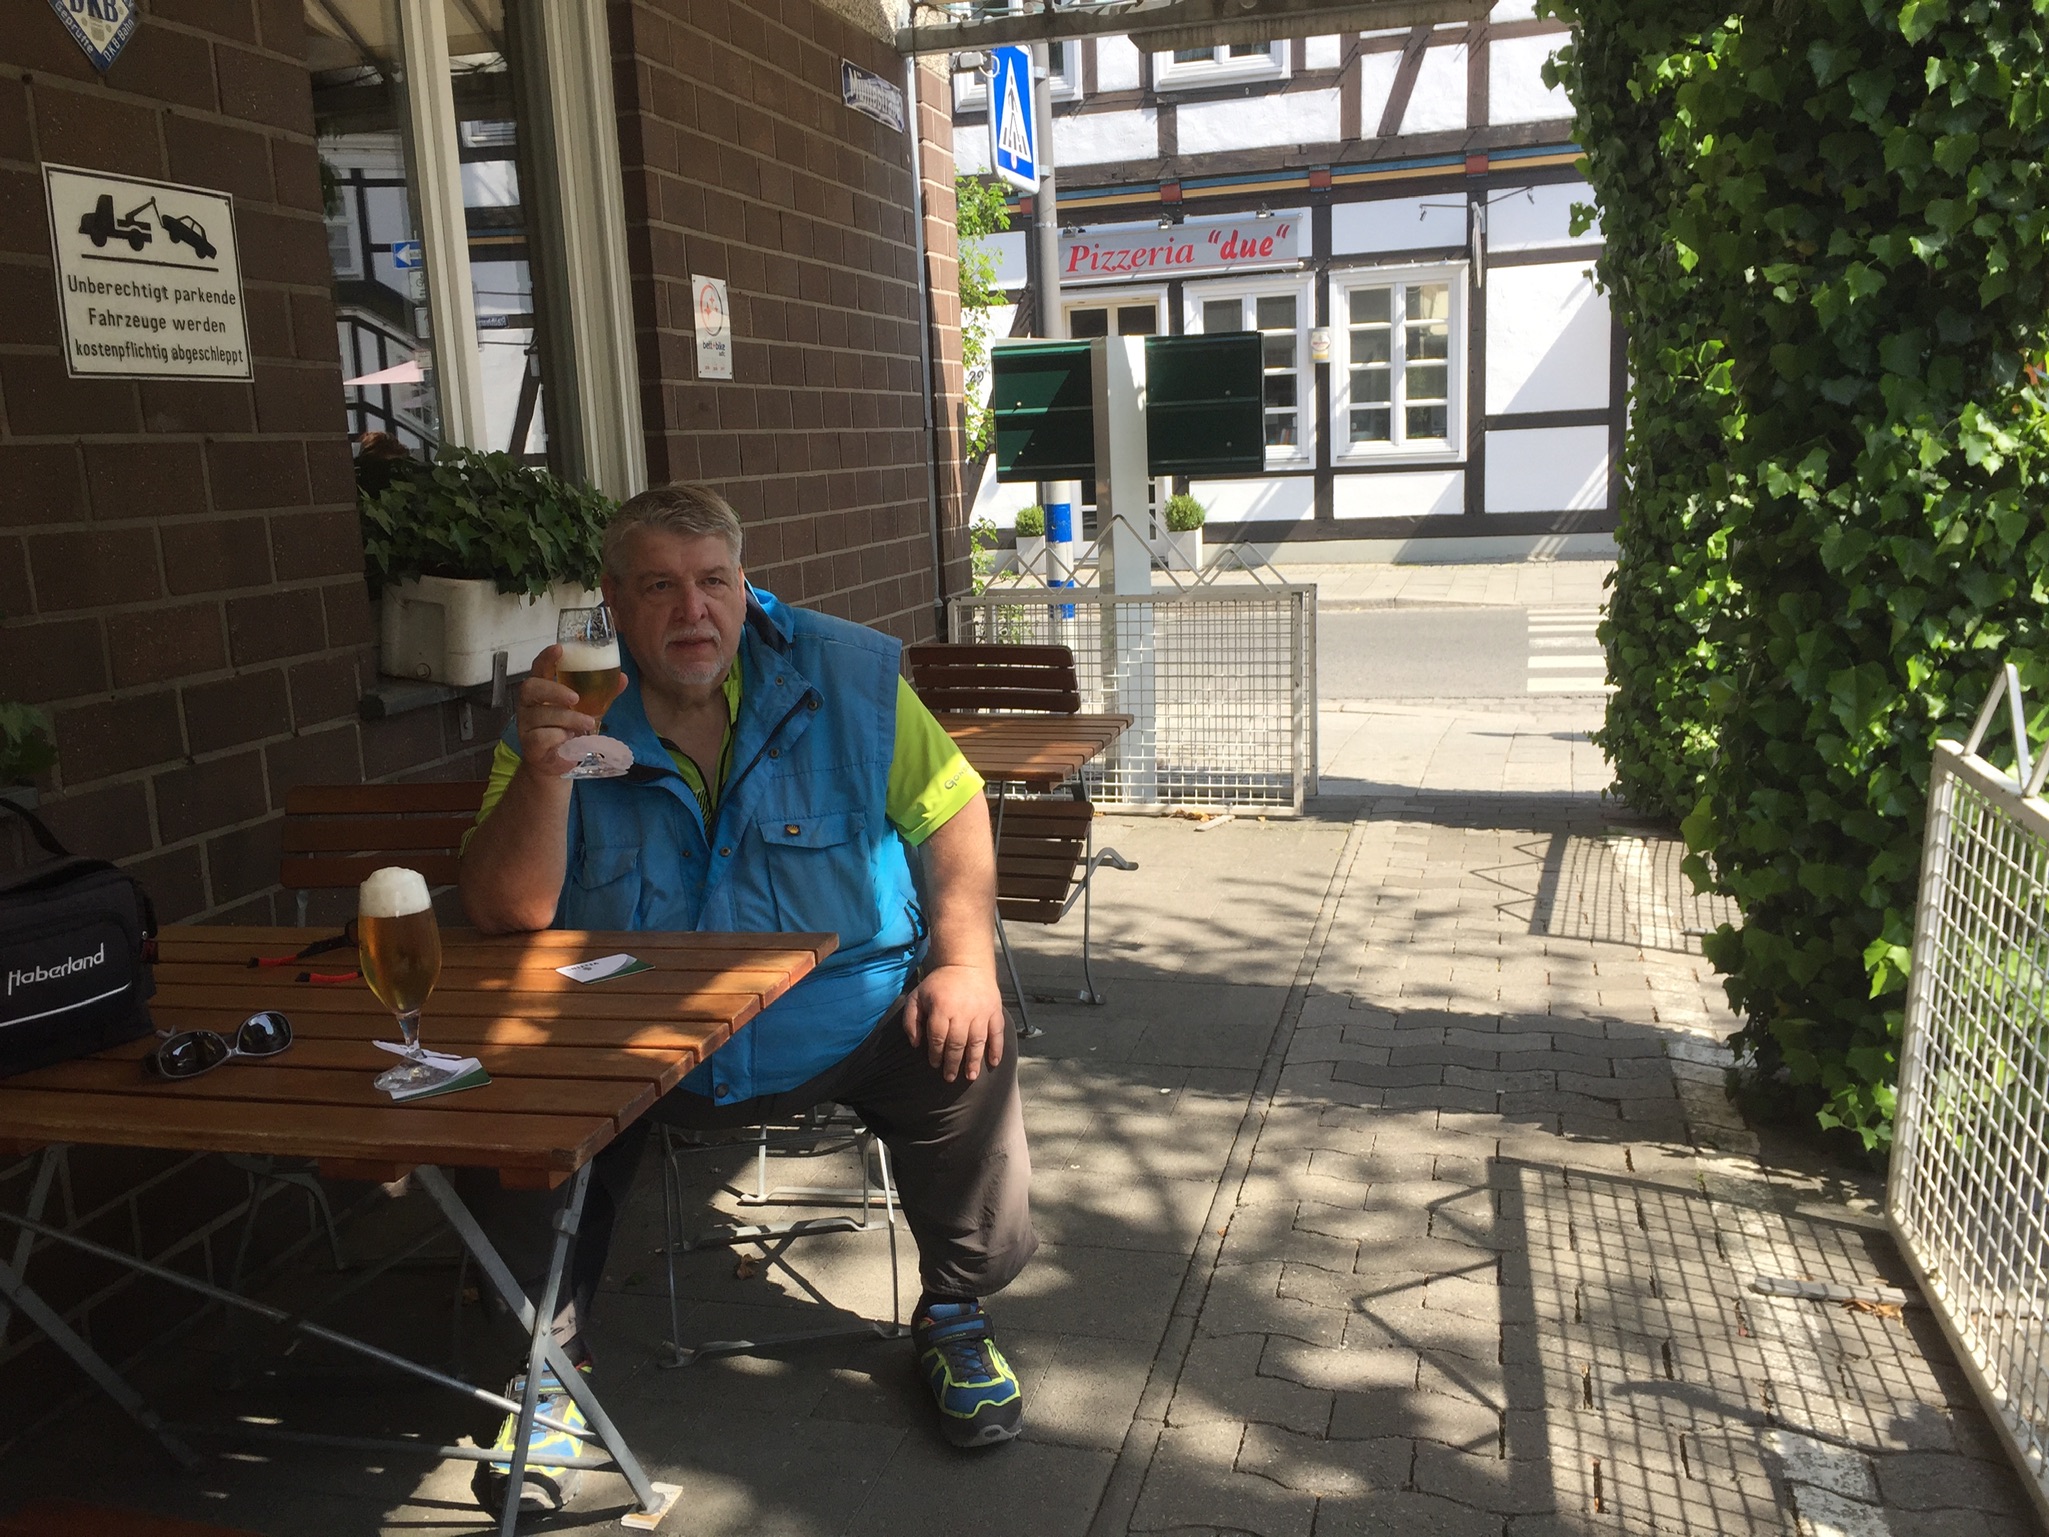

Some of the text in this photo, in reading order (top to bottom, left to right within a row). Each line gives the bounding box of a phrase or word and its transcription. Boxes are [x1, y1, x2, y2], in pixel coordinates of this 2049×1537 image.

[1066, 237, 1195, 272] Pizzeria
[67, 274, 236, 306] Unberechtigt parkende
[88, 308, 227, 333] Fahrzeuge werden
[75, 339, 243, 365] kostenpflichtig abgeschleppt
[8, 942, 104, 995] Haberland
